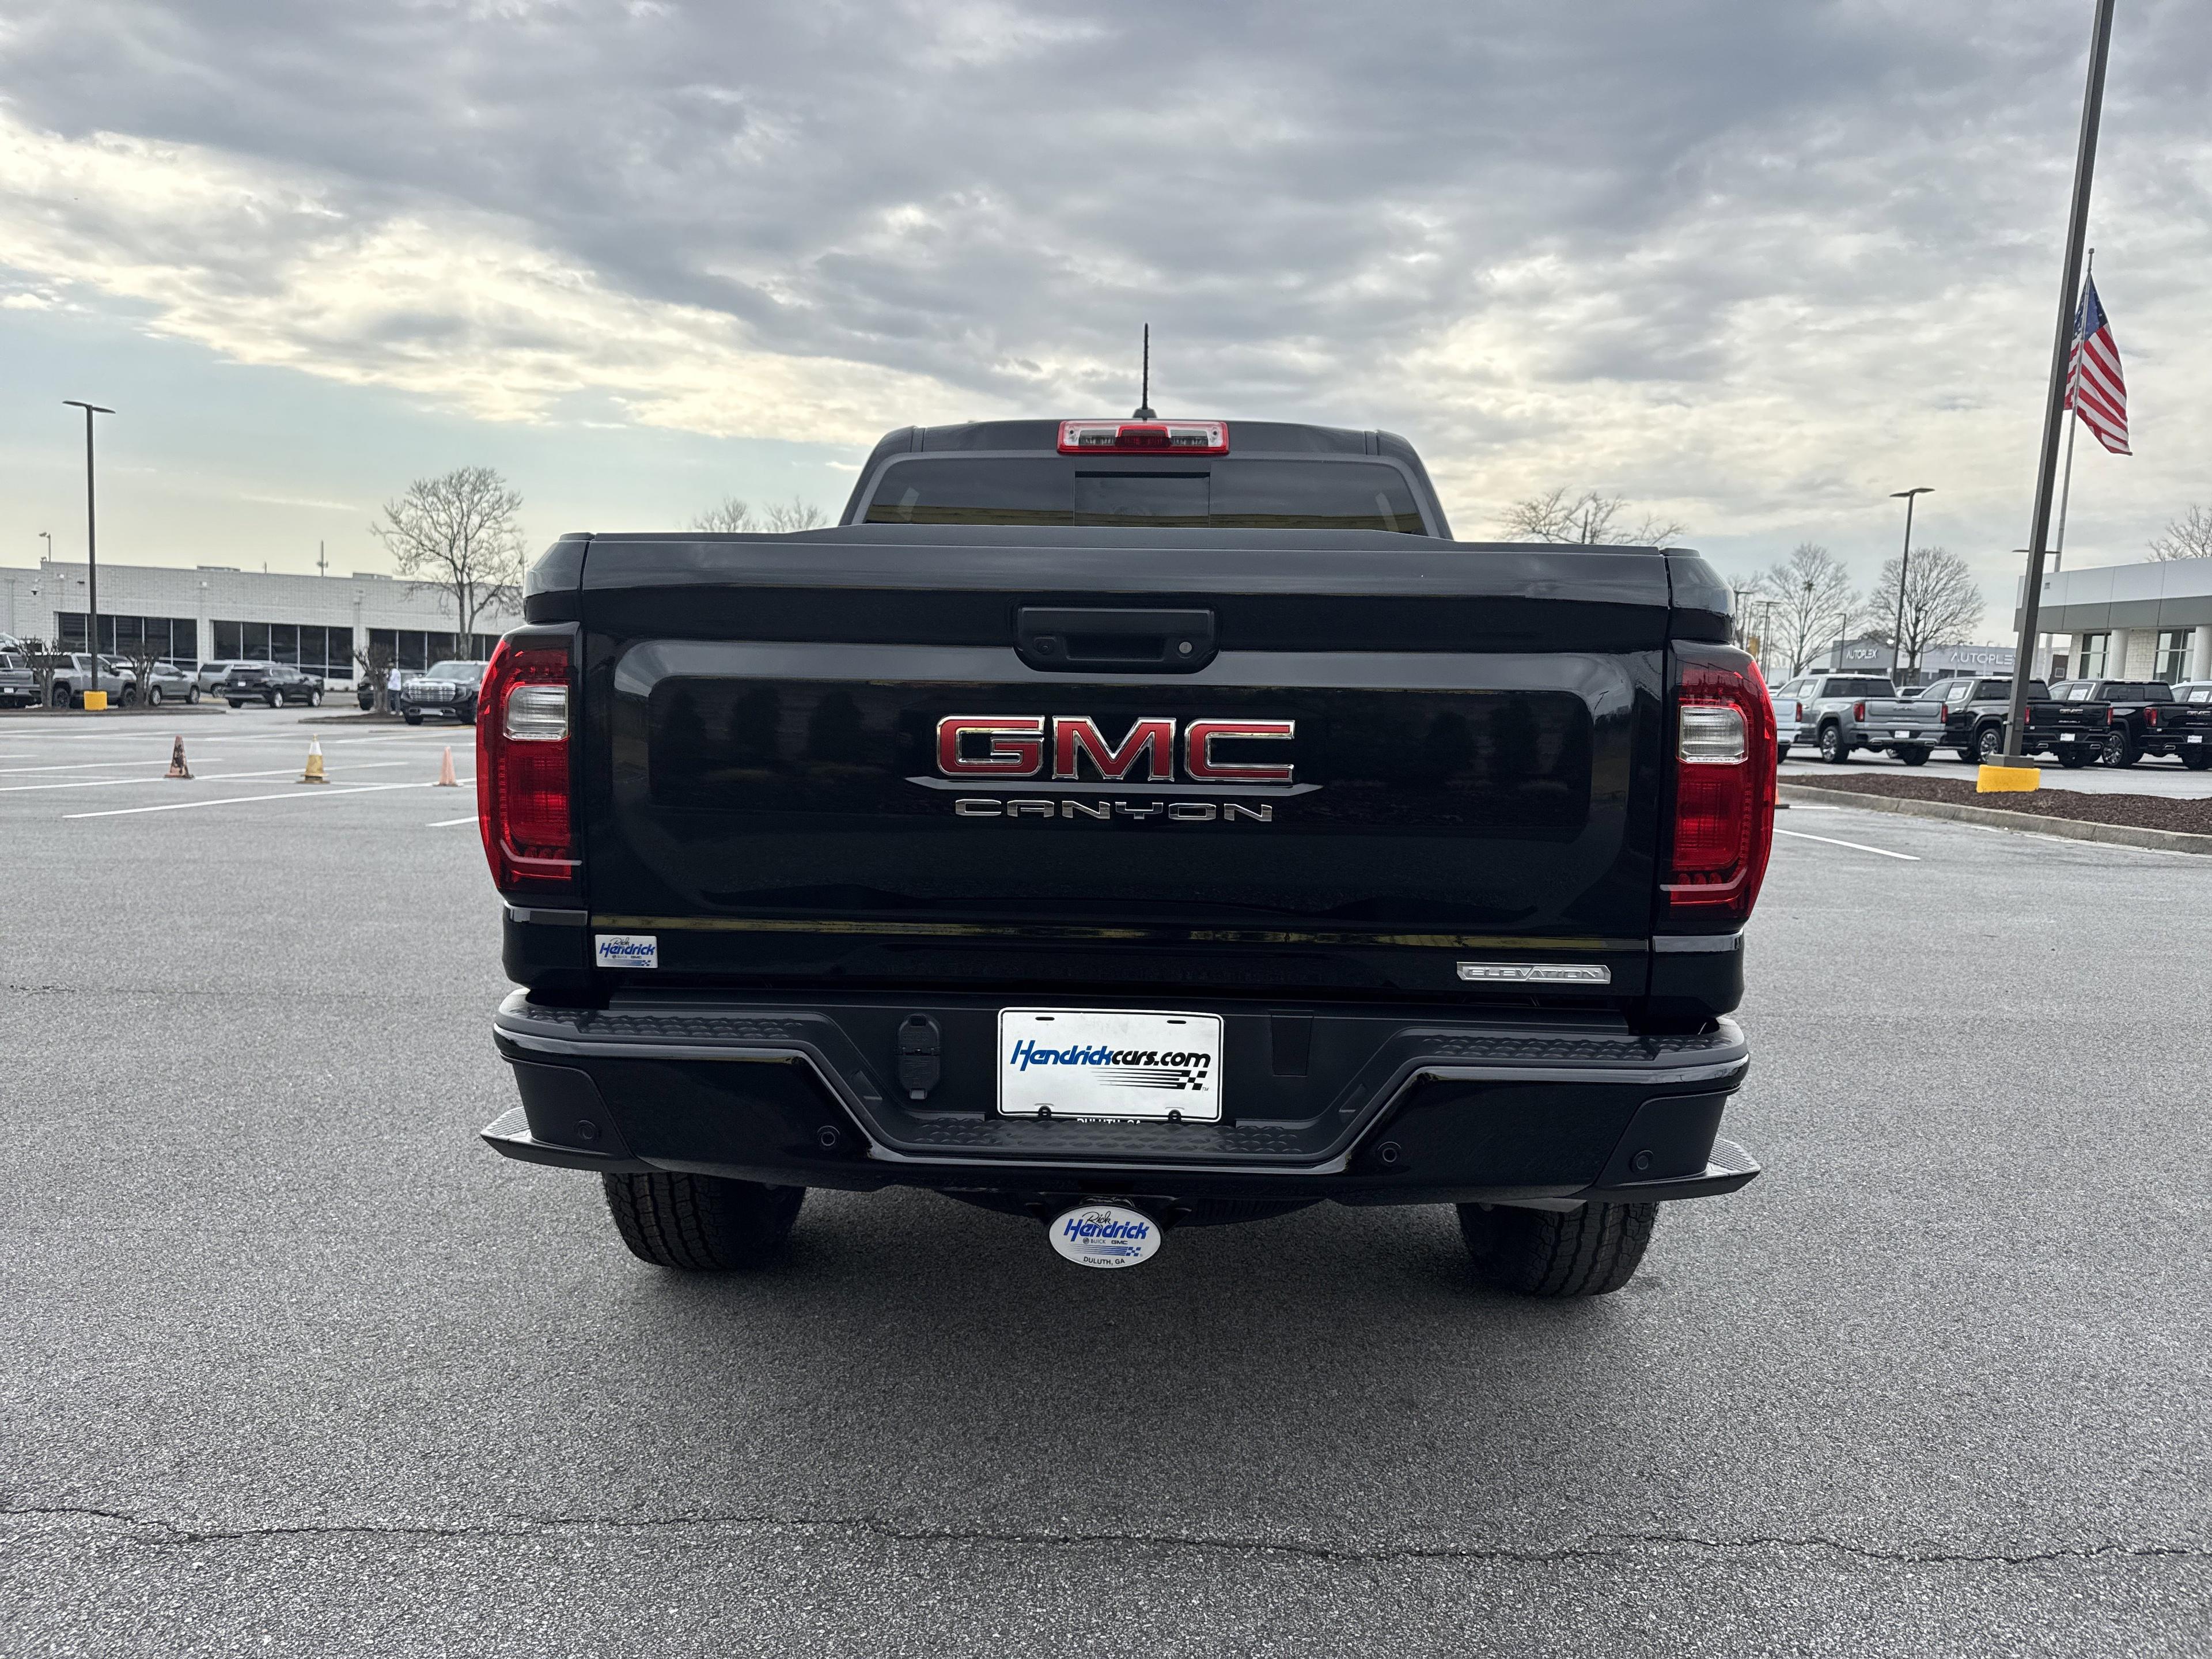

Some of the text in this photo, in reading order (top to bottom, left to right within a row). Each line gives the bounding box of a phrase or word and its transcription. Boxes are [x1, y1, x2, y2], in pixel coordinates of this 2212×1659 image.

[1846, 649, 1877, 659] AUTOPLEX
[1950, 652, 2016, 665] AUTOPLE
[937, 715, 1296, 783] GMC
[955, 799, 1272, 822] CANYON
[599, 943, 656, 957] Hendrick
[1469, 968, 1599, 978] ELEVATION
[1010, 1040, 1211, 1071] Hendrickcars.com
[1082, 1211, 1111, 1228] Rick
[1063, 1218, 1150, 1242] Hendrick
[1083, 1256, 1113, 1266] DULUTH,
